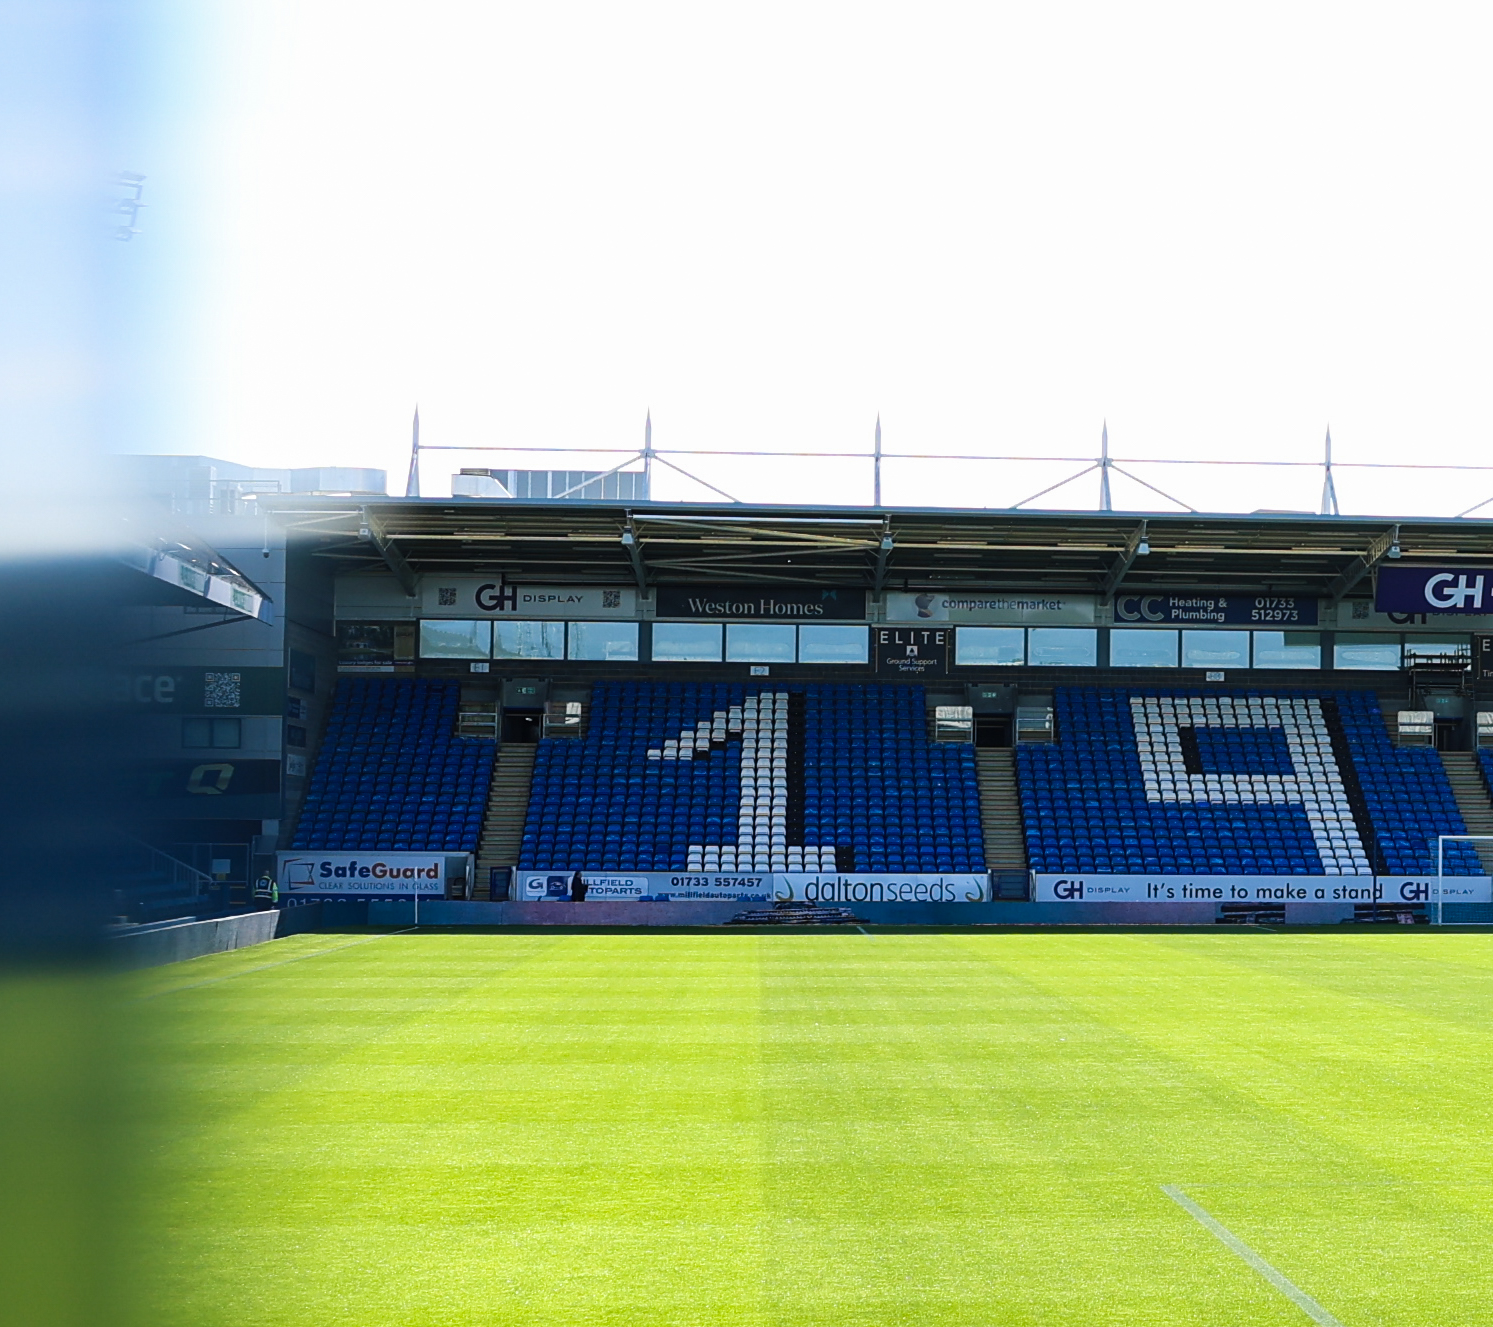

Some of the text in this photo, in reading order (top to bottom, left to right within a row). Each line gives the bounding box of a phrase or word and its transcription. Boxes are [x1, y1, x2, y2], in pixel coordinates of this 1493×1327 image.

[475, 583, 584, 612] GH DISPLAY
[1424, 572, 1485, 609] GH
[688, 597, 824, 615] Weston Homes
[941, 598, 1062, 612] comparethemarket
[1116, 594, 1165, 621] CC
[1168, 596, 1228, 610] Heating &
[1254, 597, 1295, 609] 01733
[1170, 609, 1226, 622] Plumbing
[1250, 609, 1299, 621] 512973
[879, 631, 945, 645] ELITE
[886, 657, 938, 667] Ground Support
[898, 664, 925, 672] Services
[319, 861, 439, 879] SafeGuard
[318, 882, 344, 890] CLEAR
[347, 882, 395, 891] SOLUTIONS
[398, 883, 408, 891] IN
[670, 876, 763, 887] 01733 557457
[804, 875, 956, 902] daltonseeds
[1053, 879, 1084, 900] GH
[1087, 886, 1131, 894] DISPLAY
[1146, 882, 1175, 899] It's
[1182, 882, 1224, 899] time
[1229, 883, 1249, 899] to
[1255, 882, 1307, 899] make
[1314, 885, 1326, 899] a
[1332, 882, 1384, 900] stand
[1400, 881, 1429, 901] GH
